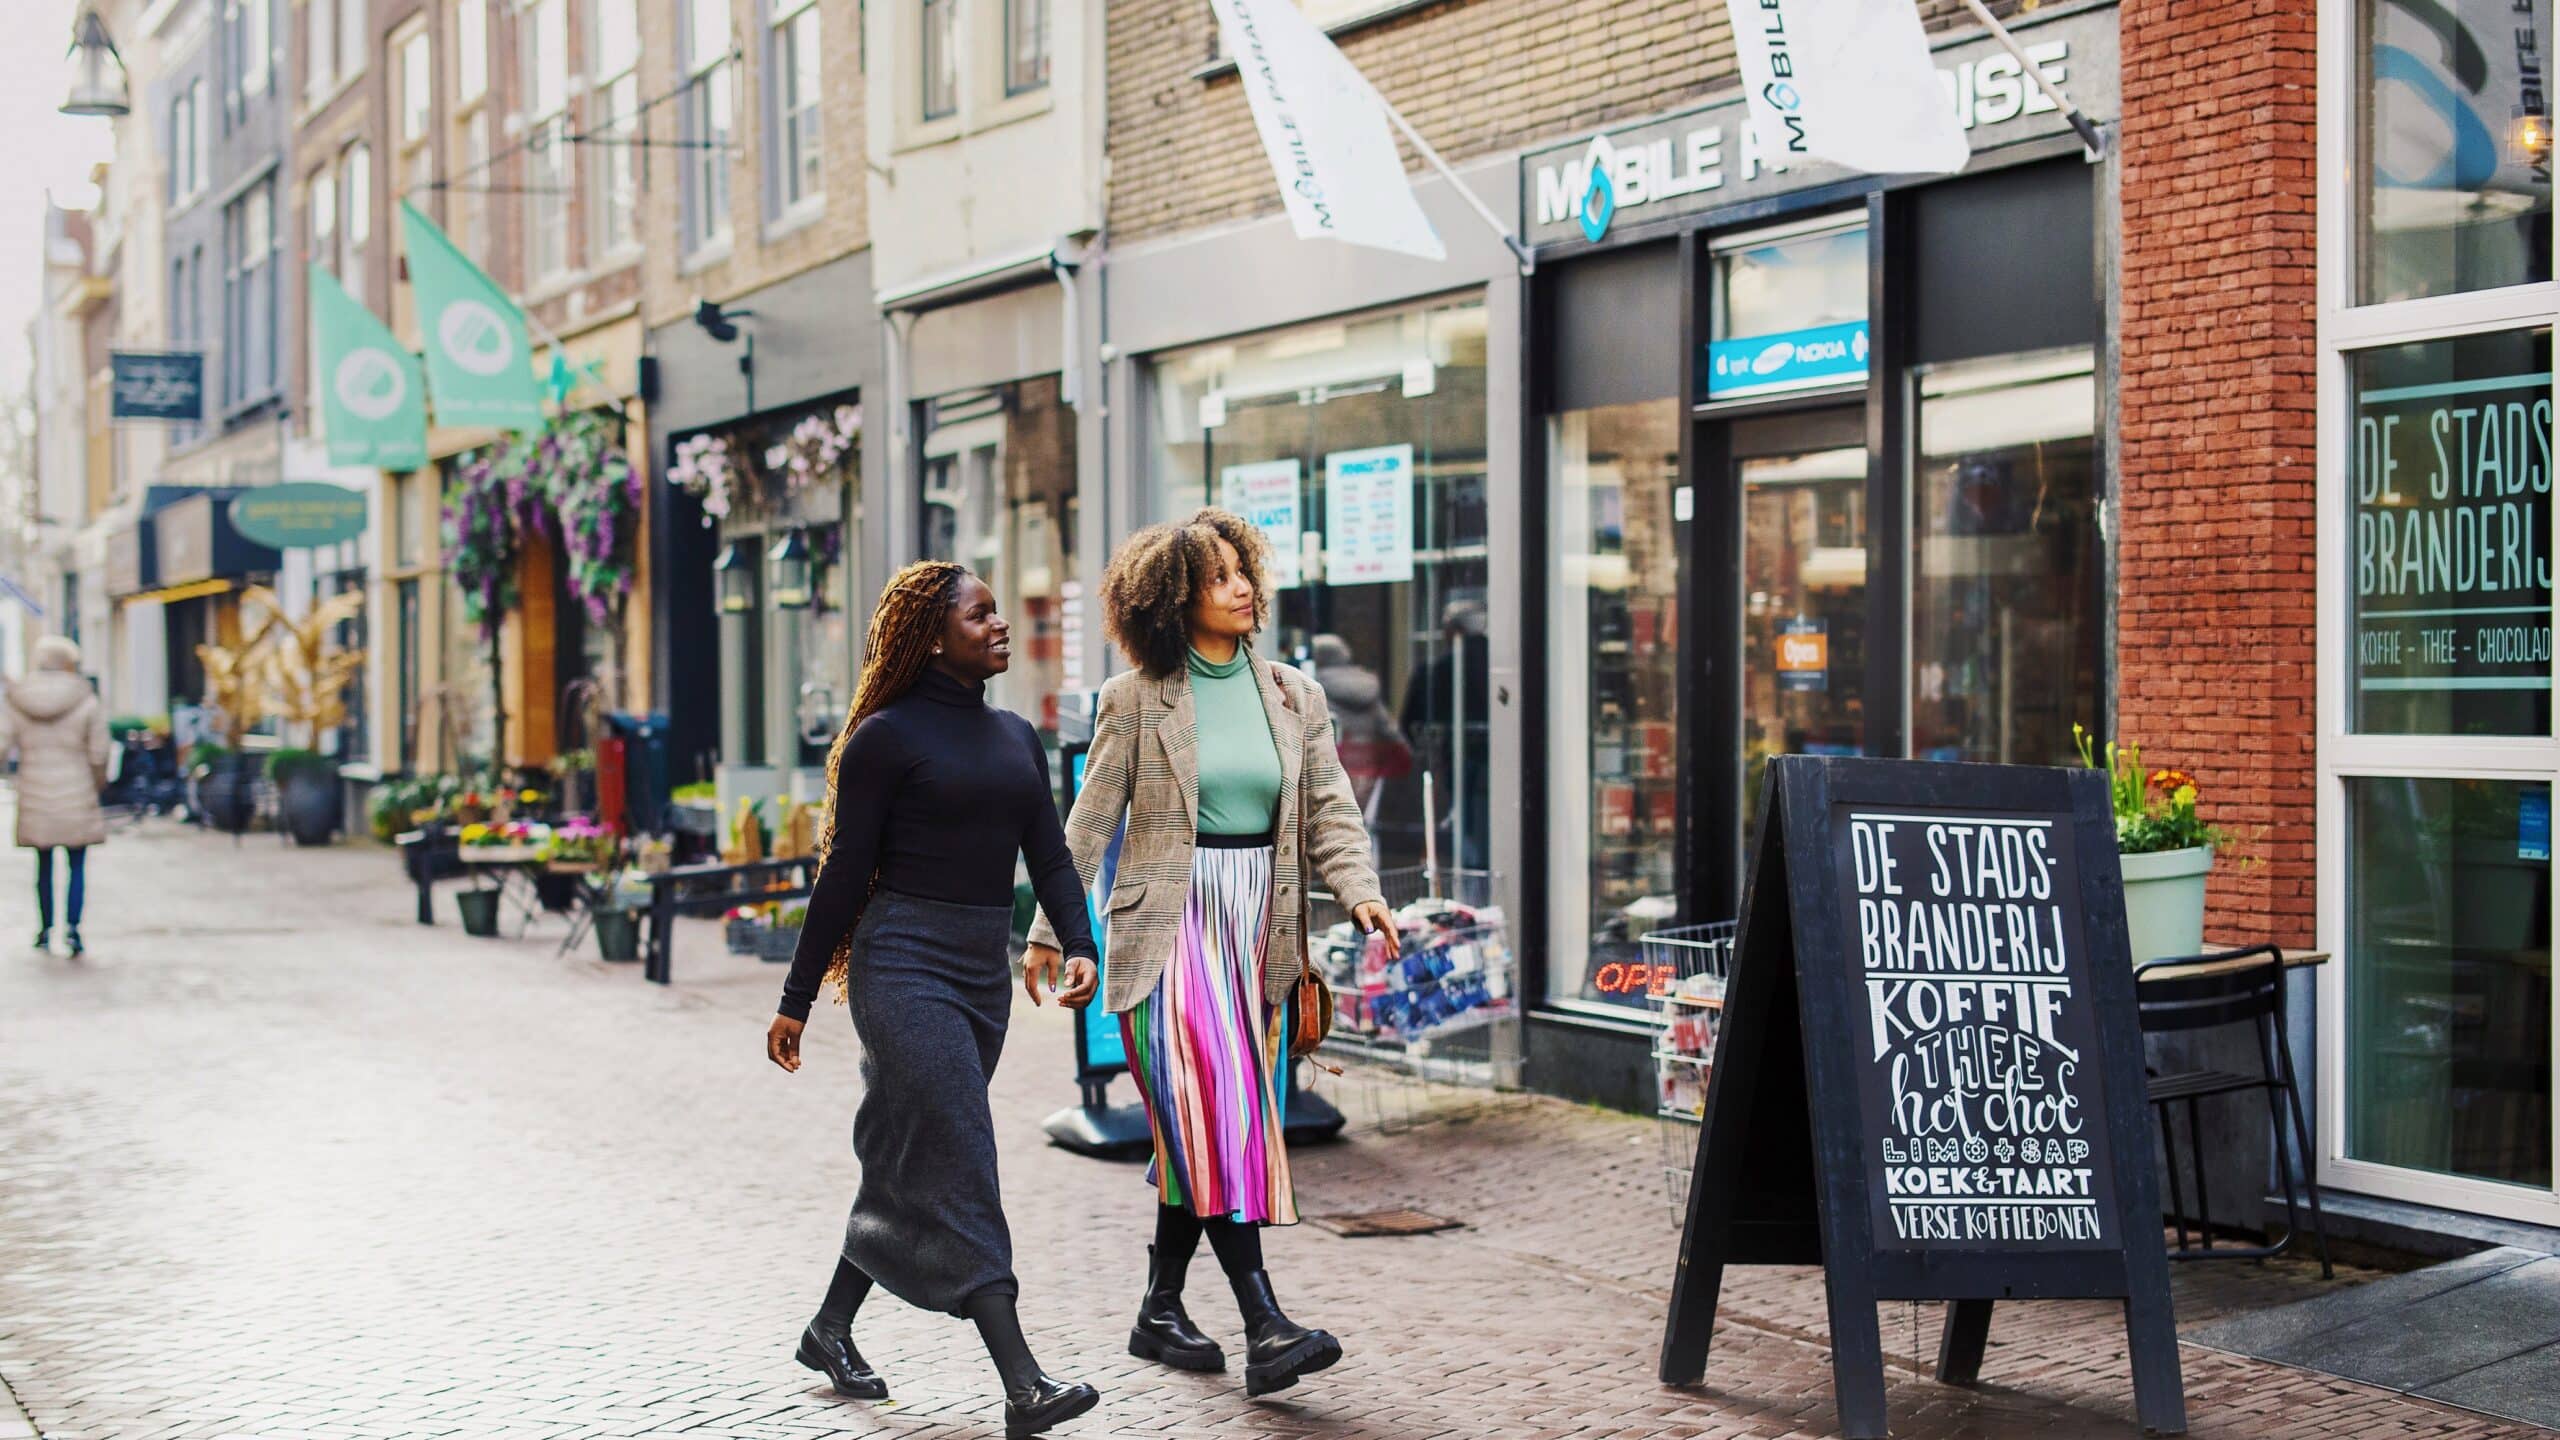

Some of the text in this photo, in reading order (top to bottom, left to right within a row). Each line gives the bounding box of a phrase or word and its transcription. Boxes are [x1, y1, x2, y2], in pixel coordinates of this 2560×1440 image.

[1278, 111, 1334, 229] MOBILE
[1537, 126, 1723, 244] MOBILE
[2359, 398, 2553, 505] DE STADS
[2360, 630, 2402, 665] KOFFIE
[2421, 629, 2457, 663] THEE
[2477, 626, 2551, 664] CHOCOLAD
[1851, 821, 2057, 900] DE STADS-
[1858, 898, 2066, 974] BRANDERIJ
[1864, 979, 2080, 1064] KOFFIE
[1914, 1024, 2045, 1091] THEE
[1891, 1052, 2084, 1144] hot choc
[1890, 1205, 1962, 1240] VERSE
